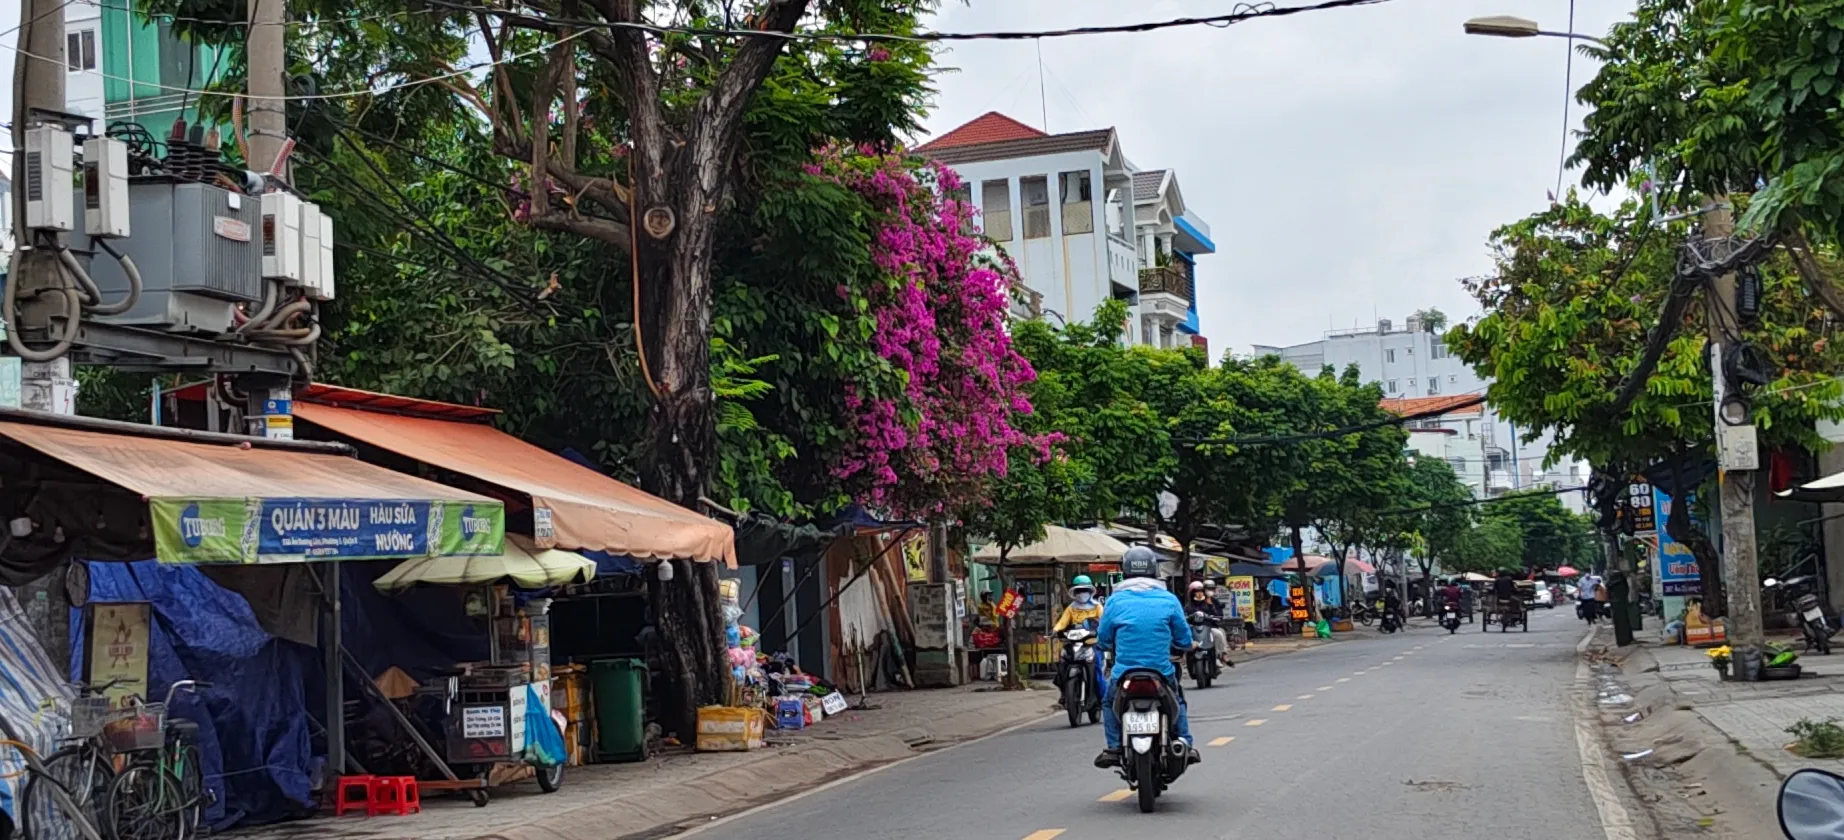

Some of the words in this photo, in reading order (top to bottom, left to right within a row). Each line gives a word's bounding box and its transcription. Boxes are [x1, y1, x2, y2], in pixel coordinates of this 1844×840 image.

[271, 502, 314, 535] QUÁN
[316, 508, 326, 530] 3
[328, 503, 360, 530] MÀU
[370, 503, 392, 524] HÀU
[394, 503, 416, 524] SỮA
[375, 529, 414, 550] NƯỚNG
